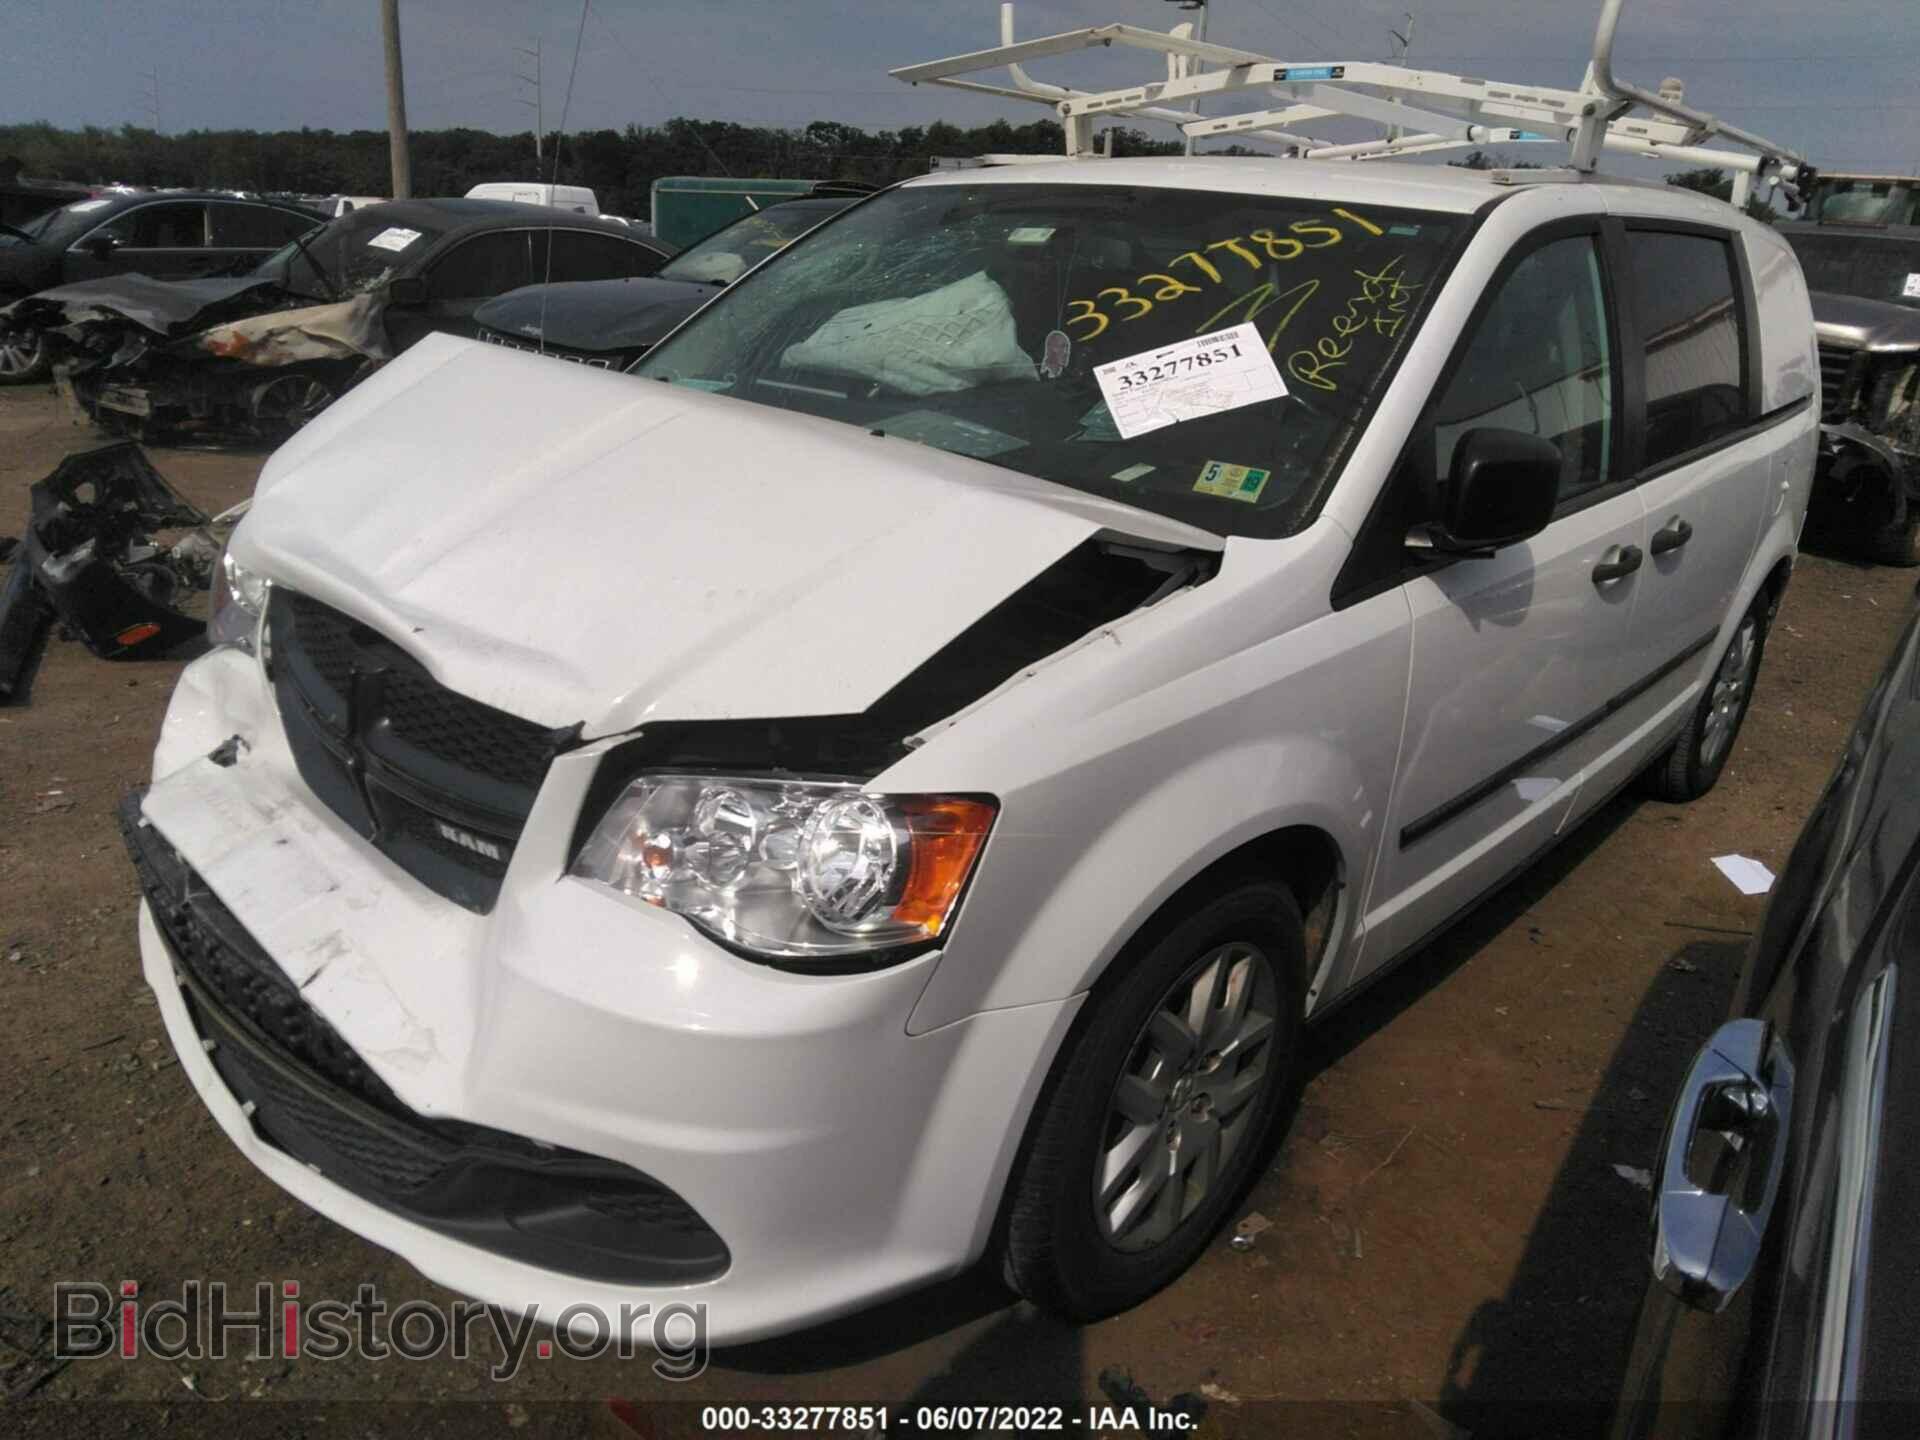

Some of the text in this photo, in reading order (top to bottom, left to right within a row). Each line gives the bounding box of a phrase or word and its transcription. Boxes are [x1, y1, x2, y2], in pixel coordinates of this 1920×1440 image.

[1067, 208, 1384, 342] 33277851
[1118, 343, 1243, 390] 33277851
[1205, 463, 1221, 482] 5
[440, 825, 499, 860] RAM
